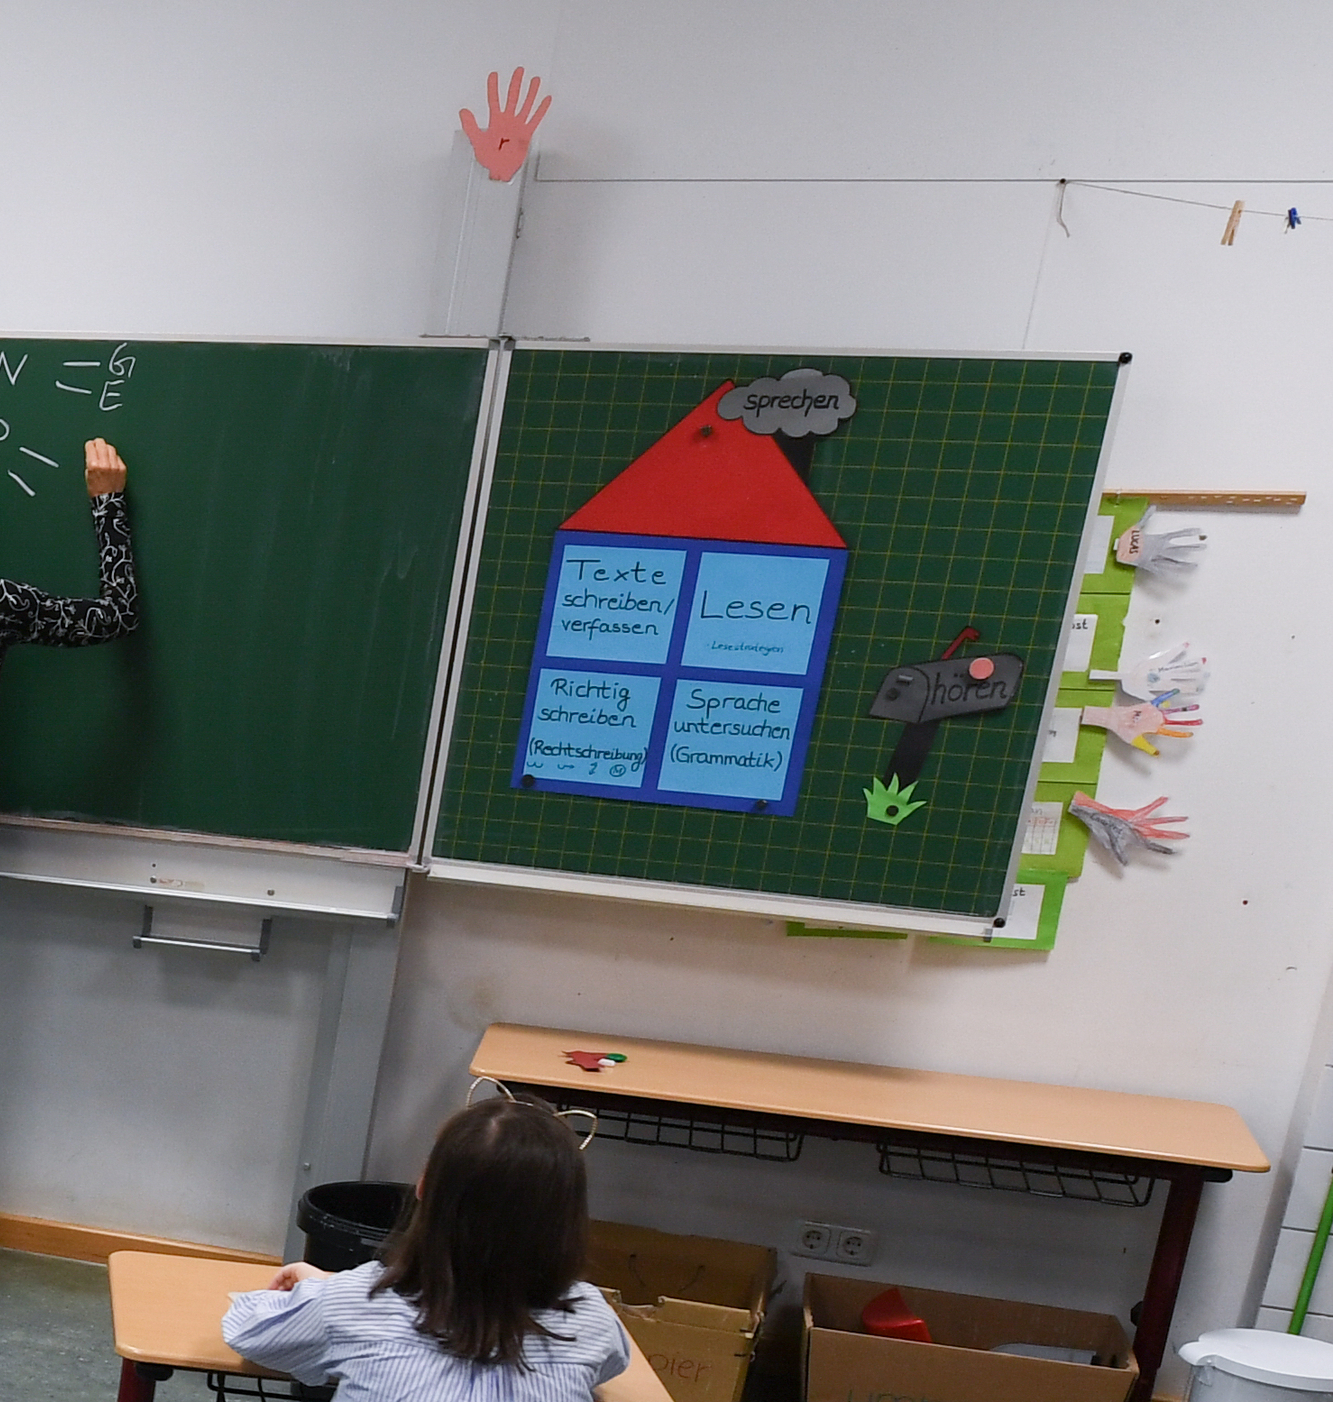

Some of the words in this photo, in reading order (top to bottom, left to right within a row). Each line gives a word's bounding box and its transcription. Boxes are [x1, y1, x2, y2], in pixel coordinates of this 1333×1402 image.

[109, 342, 136, 378] G
[100, 380, 124, 410] E
[743, 386, 840, 417] sprechen
[566, 559, 666, 585] Texte
[700, 590, 811, 624] Lesen
[562, 618, 659, 641] verfassen
[550, 677, 631, 712] Richtig
[686, 688, 781, 719] Sprache
[931, 672, 1008, 705] hören
[537, 705, 637, 728] schreiben
[674, 717, 790, 740] untersuchen
[670, 743, 783, 772] (Grammatik)
